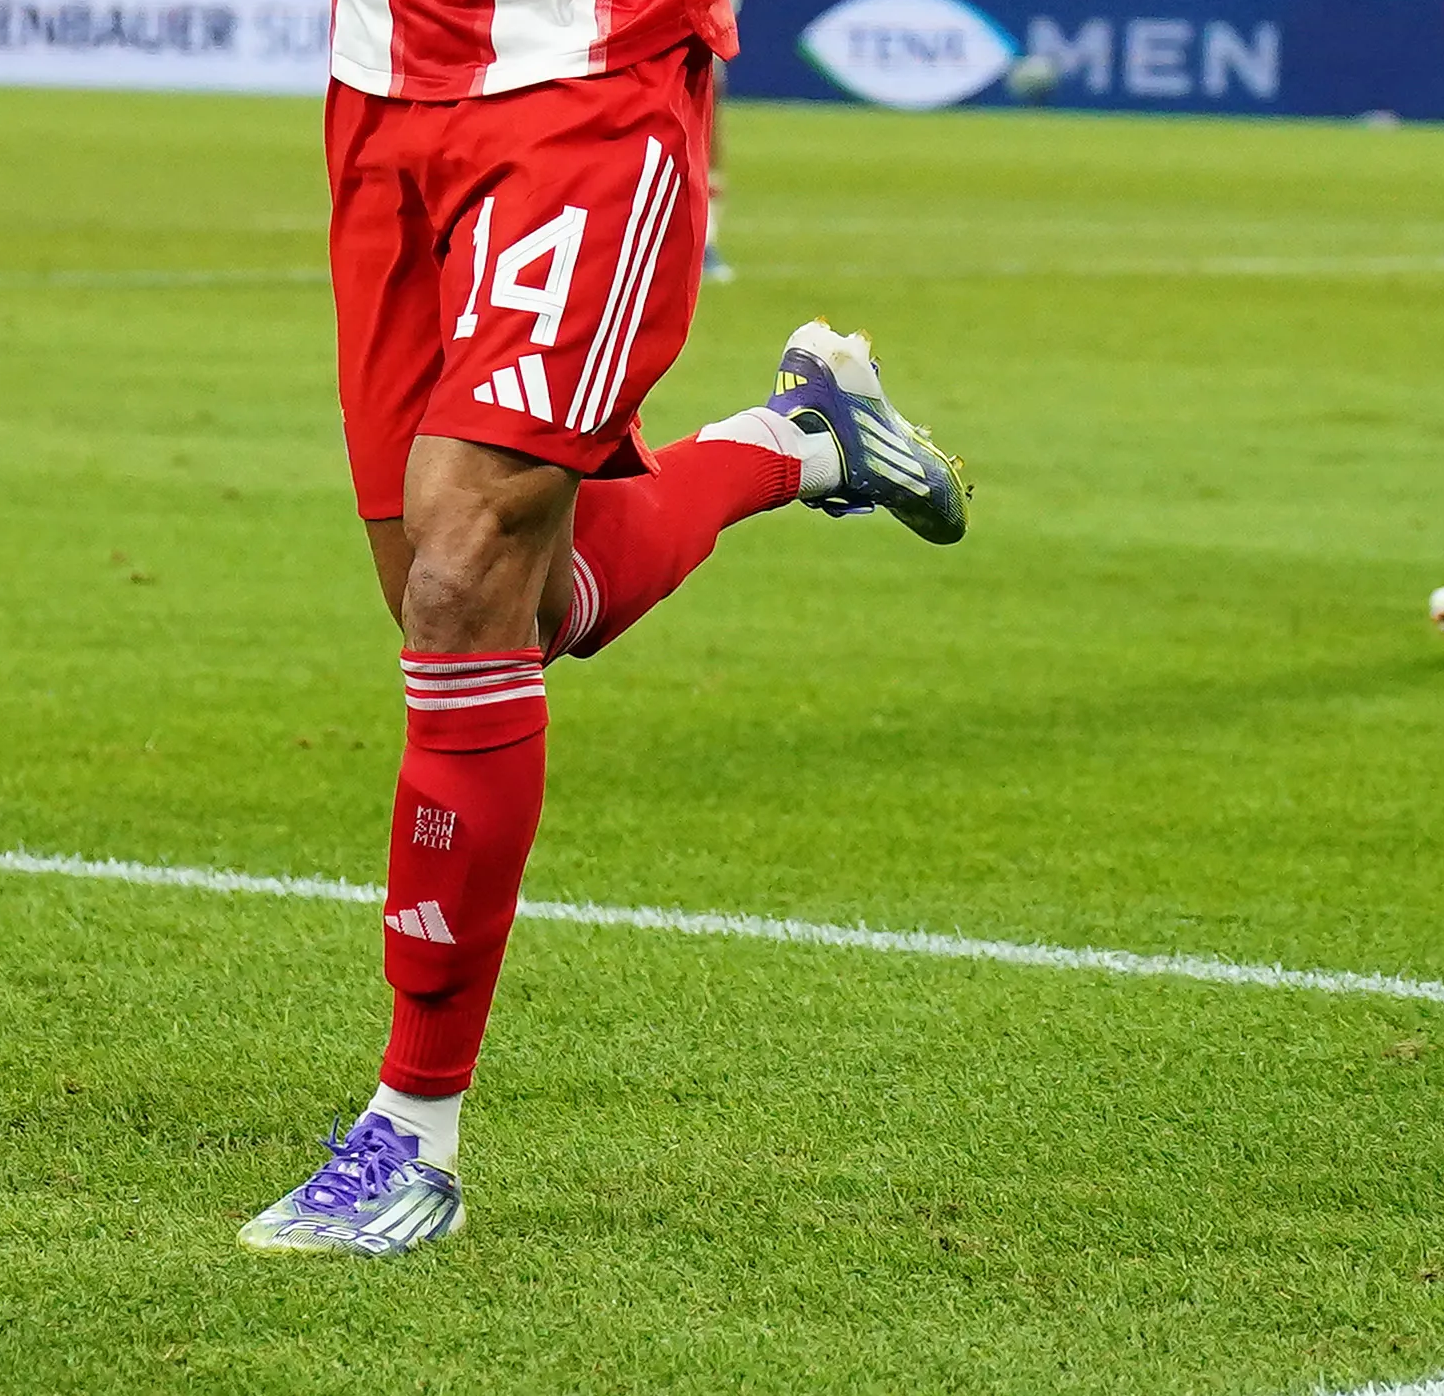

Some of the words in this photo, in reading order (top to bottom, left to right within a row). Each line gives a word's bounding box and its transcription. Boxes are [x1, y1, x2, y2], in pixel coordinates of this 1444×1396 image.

[1025, 15, 1283, 101] MEN
[452, 196, 589, 347] 14
[417, 805, 456, 824] MIA
[415, 819, 453, 838] SAN
[412, 832, 451, 850] MIA
